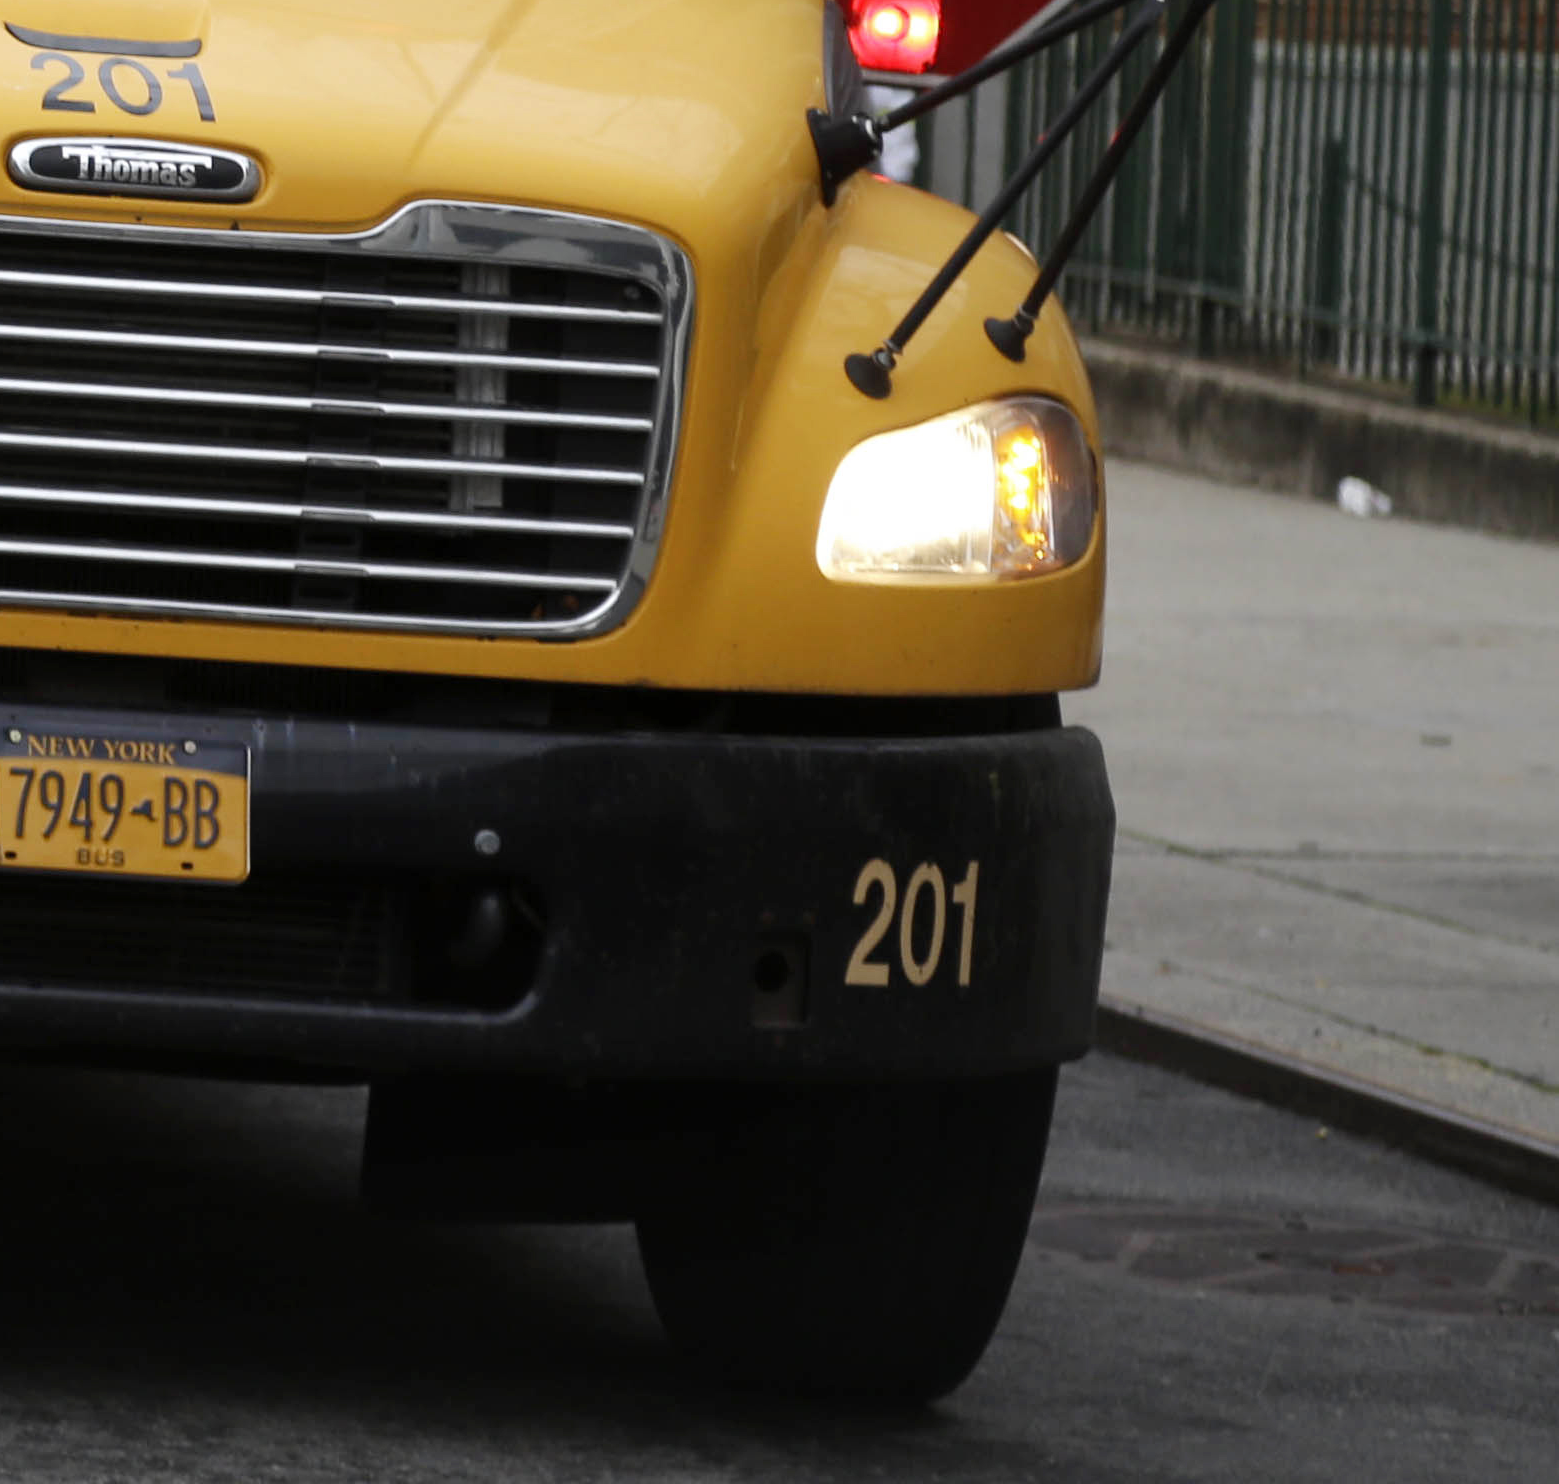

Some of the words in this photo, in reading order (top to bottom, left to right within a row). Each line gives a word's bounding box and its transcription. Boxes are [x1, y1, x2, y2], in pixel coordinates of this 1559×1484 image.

[30, 51, 217, 123] 201
[62, 145, 212, 188] Thomas
[27, 734, 95, 758] NEW
[104, 739, 177, 766] YORK
[163, 776, 221, 850] BB
[77, 847, 126, 866] BUS
[844, 857, 979, 987] 201
